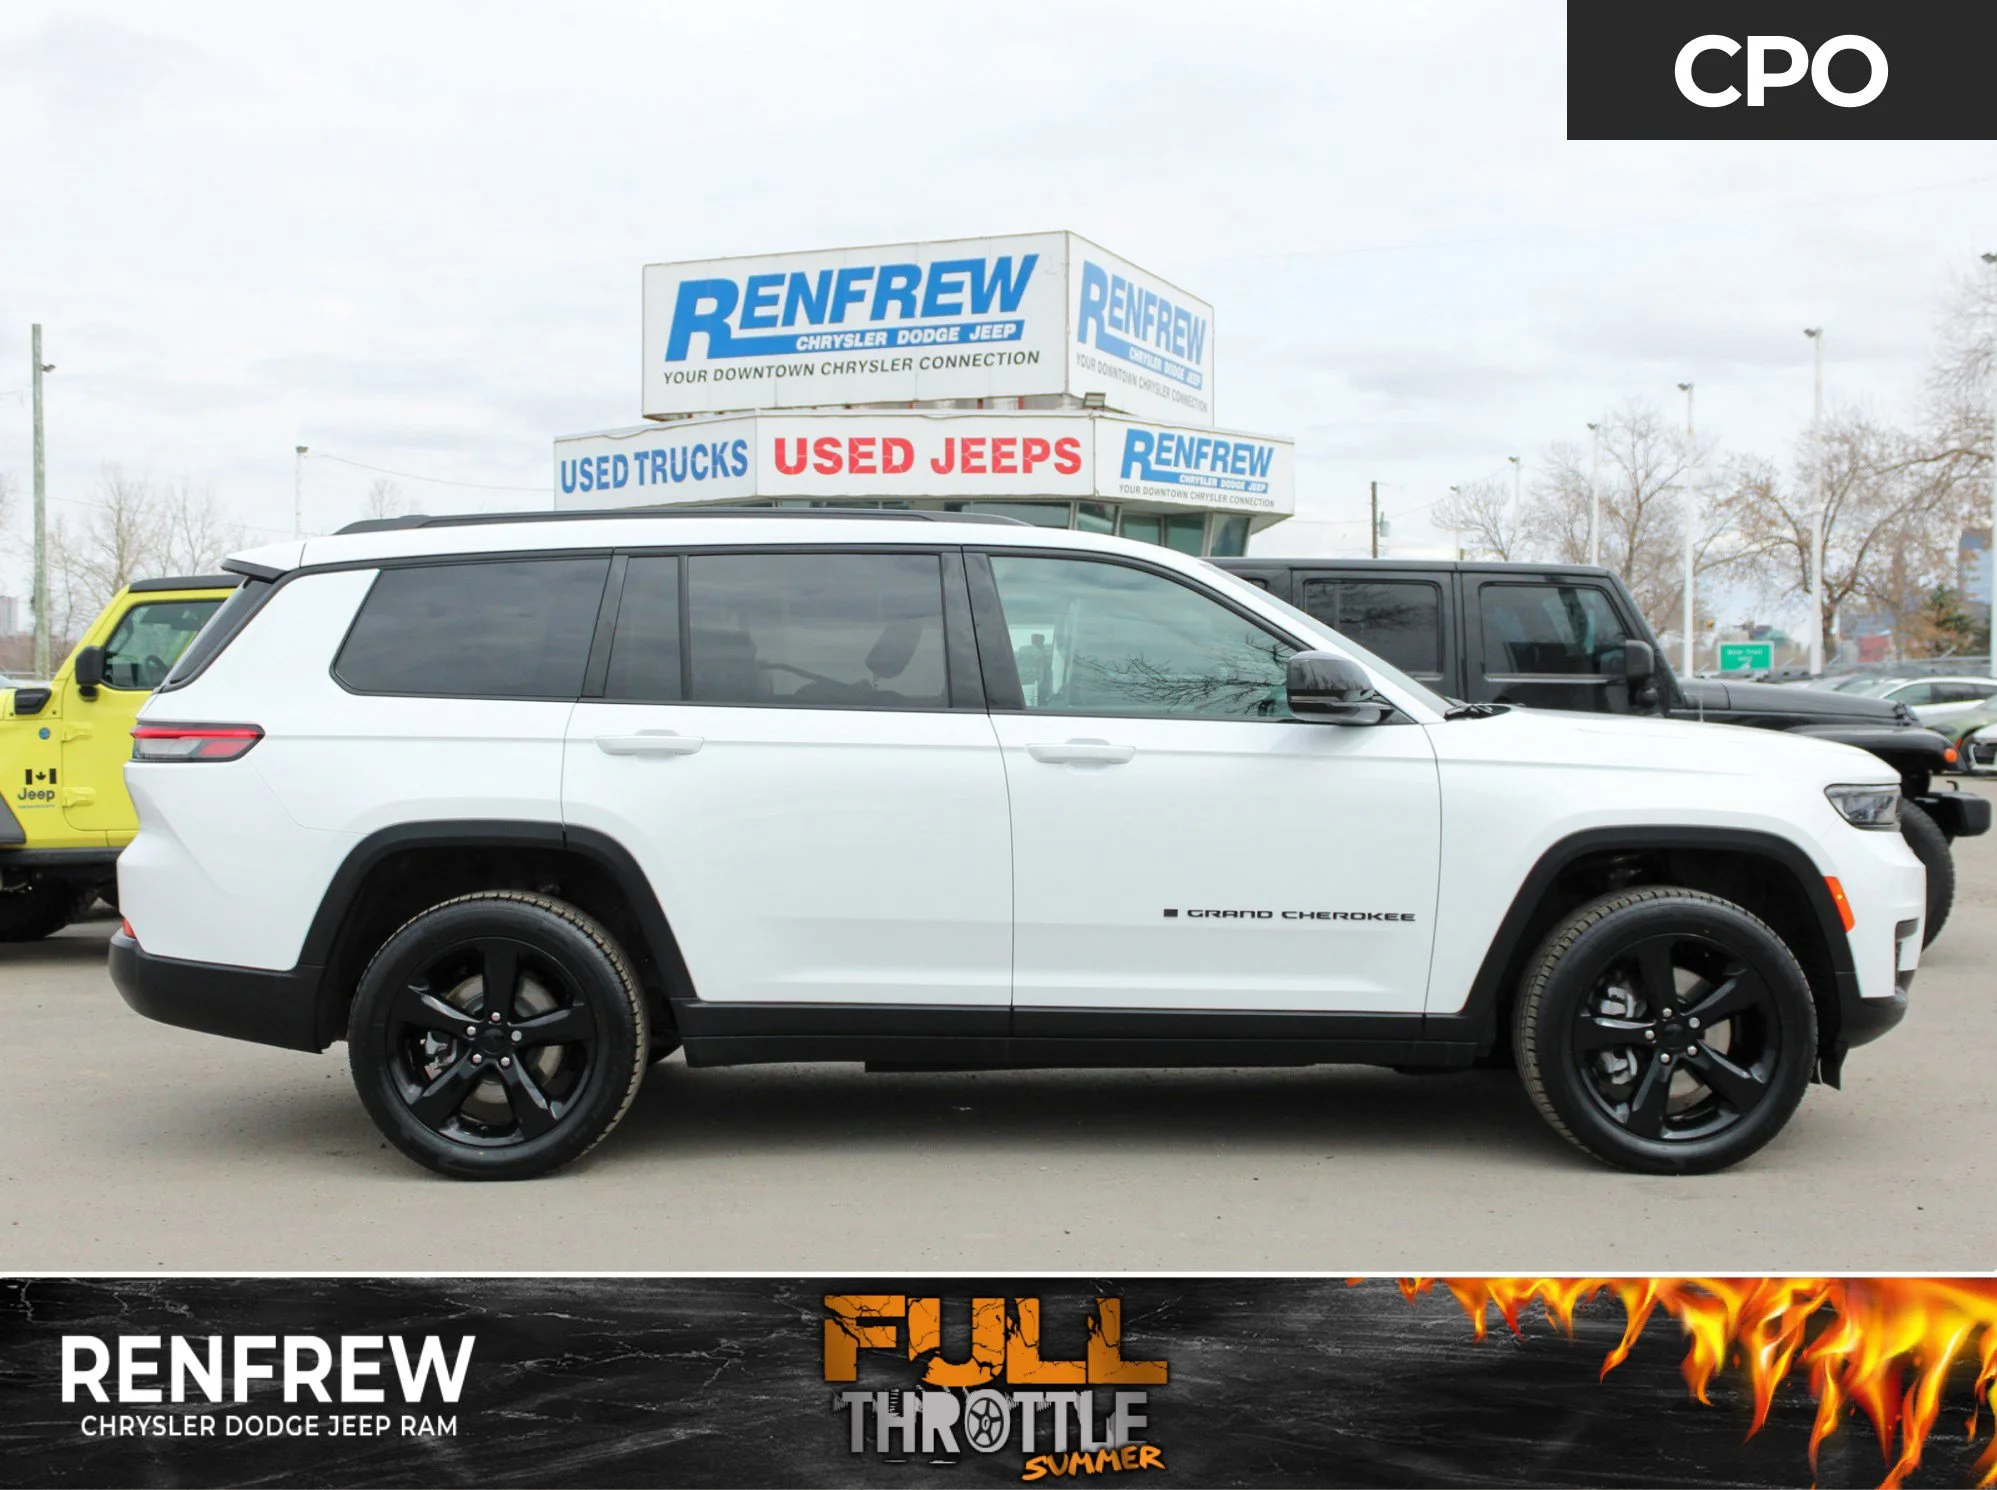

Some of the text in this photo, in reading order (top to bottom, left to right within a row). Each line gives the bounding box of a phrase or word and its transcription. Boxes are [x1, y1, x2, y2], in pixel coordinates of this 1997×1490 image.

[665, 254, 1039, 361] RENFREW
[1077, 259, 1206, 366] RENFREW
[795, 323, 1017, 352] CHRYSLER DODGE JEEP
[664, 350, 1040, 384] YOUR DOWNTOWN CHRYSLER CONNECTION
[1076, 352, 1096, 372] YOUR
[1097, 360, 1137, 386] DOWNTOWN
[1139, 376, 1170, 398] CHRYSLER
[561, 439, 748, 494] USED TRUCKS
[774, 437, 1082, 475] USED JEEPS
[1120, 428, 1274, 480] RENFREW
[1119, 484, 1275, 508] YOUR DOWNTOWN CHRYSLER CONNECTION
[1179, 473, 1218, 488] CHRYSLER
[17, 787, 55, 802] Jeep
[1187, 909, 1416, 922] GRAND CHEROKEE
